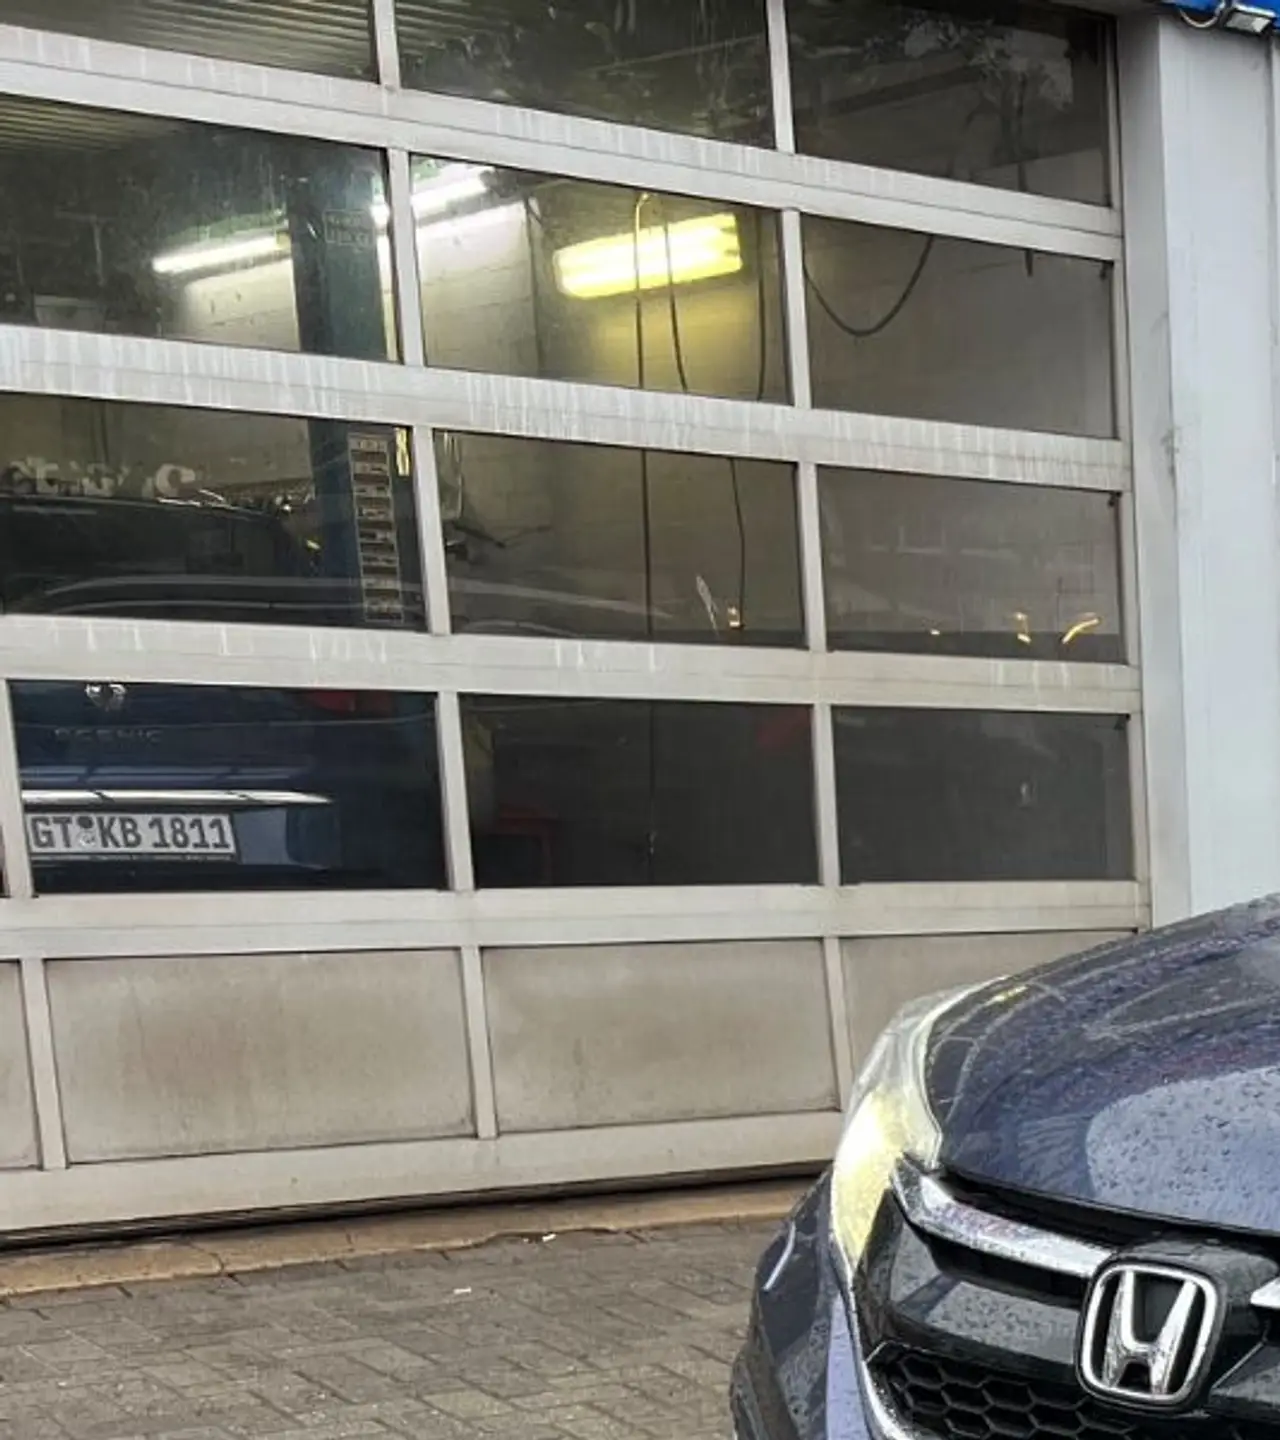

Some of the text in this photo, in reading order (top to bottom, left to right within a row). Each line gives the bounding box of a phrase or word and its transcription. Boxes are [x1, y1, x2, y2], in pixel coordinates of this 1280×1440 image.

[30, 816, 231, 849] GT KB 1811
